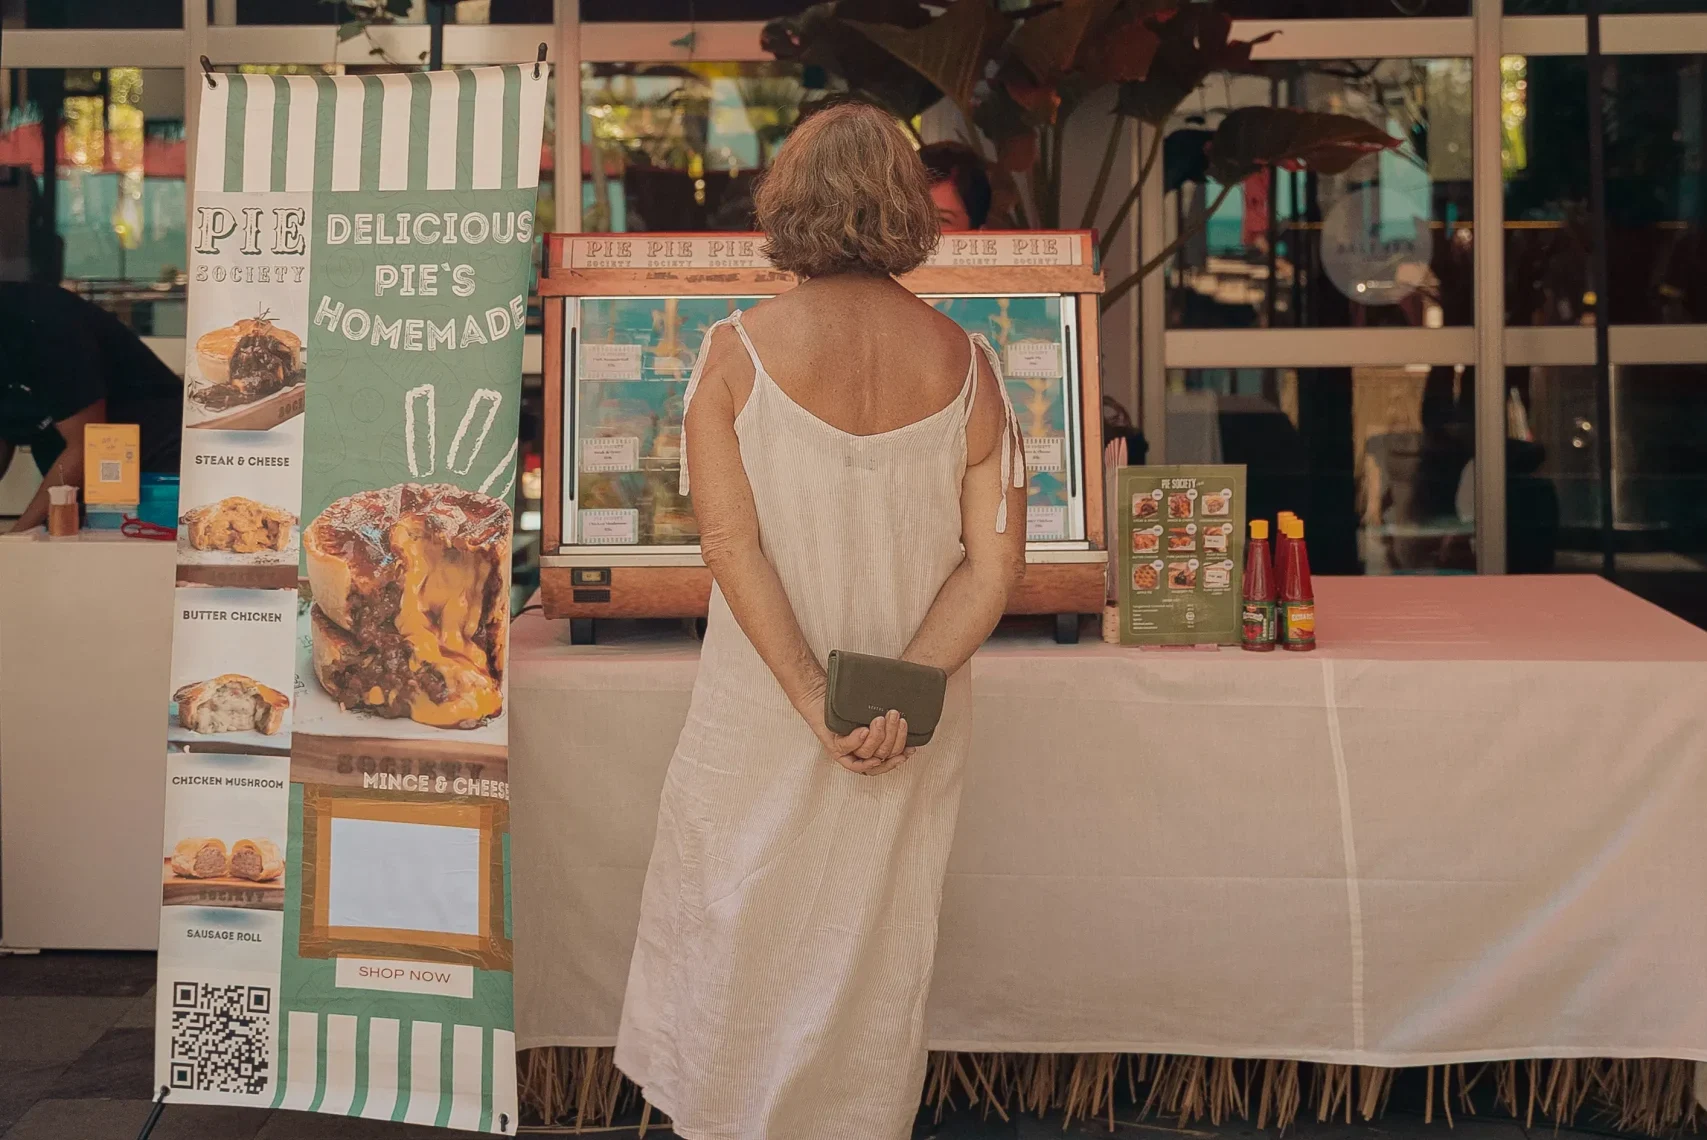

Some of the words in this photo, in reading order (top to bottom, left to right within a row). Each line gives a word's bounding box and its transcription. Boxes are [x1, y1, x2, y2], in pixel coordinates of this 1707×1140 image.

[195, 206, 306, 256] PIE
[326, 209, 533, 246] DELICIOUS
[586, 240, 632, 258] PIE
[647, 240, 692, 258] PIE
[708, 240, 754, 258] PIE
[952, 238, 998, 256] PIE
[1012, 238, 1058, 256] PIE
[196, 264, 306, 283] SOCIETY
[586, 260, 632, 268] SOCIETY
[312, 294, 525, 351] HOMEMADE
[195, 455, 234, 466] STEAK
[237, 456, 245, 466] &
[248, 457, 290, 467] CHEESE
[1172, 478, 1196, 489] SOCIETY
[183, 610, 227, 621] BUTTER
[231, 612, 282, 622] CHICKEN
[172, 776, 223, 786] CHICKEN
[225, 778, 284, 789] MUSHROOM
[363, 771, 429, 792] MINCE
[435, 775, 448, 793] &
[186, 929, 235, 941] SAUSAGE
[237, 932, 262, 942] ROLL
[358, 965, 405, 980] SHOP
[409, 969, 452, 984] NOW
